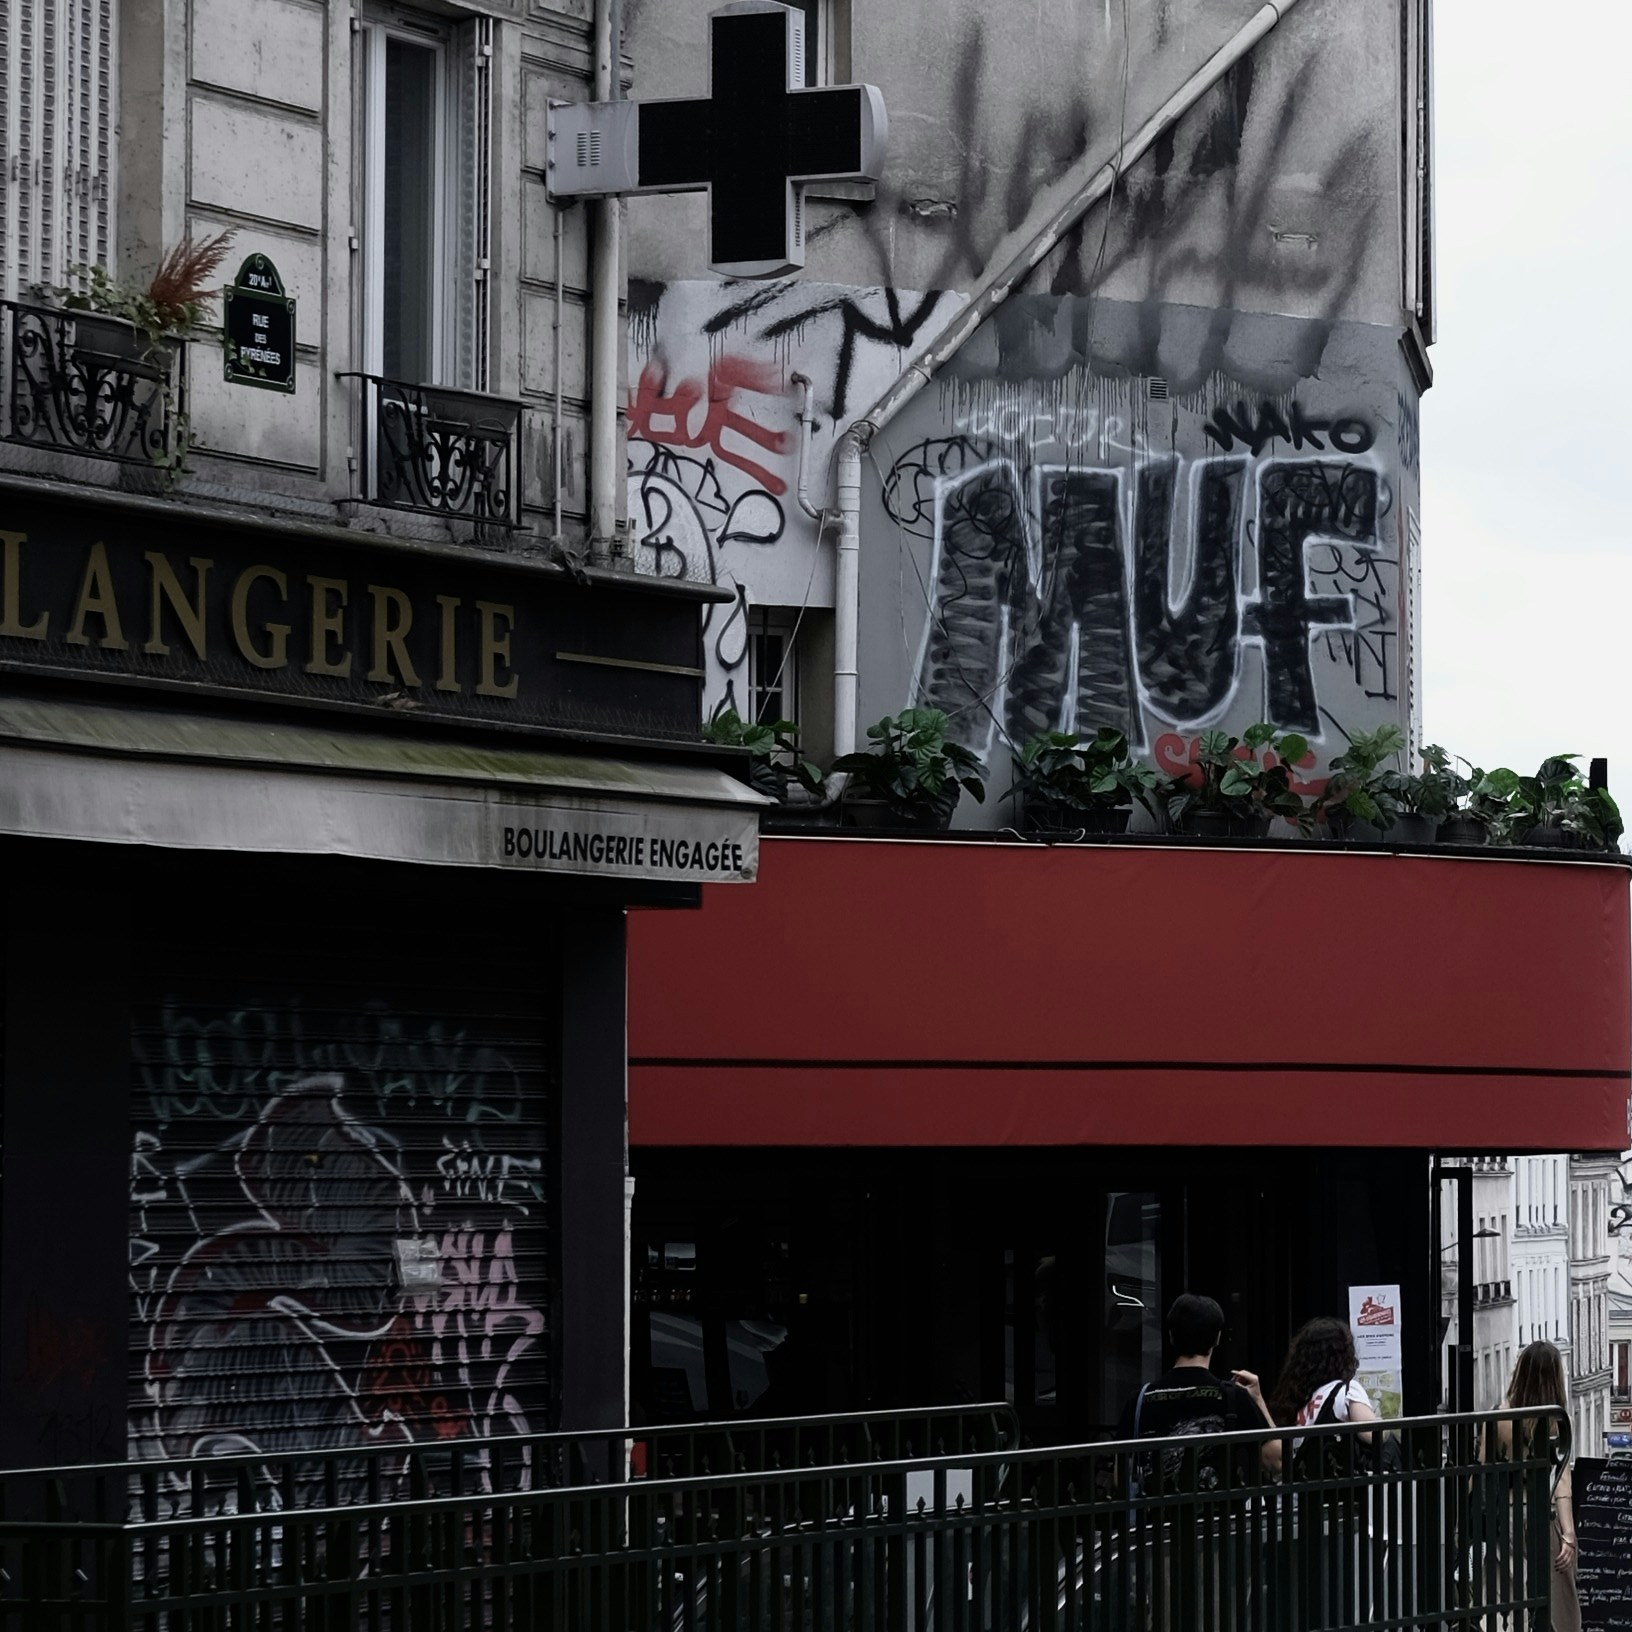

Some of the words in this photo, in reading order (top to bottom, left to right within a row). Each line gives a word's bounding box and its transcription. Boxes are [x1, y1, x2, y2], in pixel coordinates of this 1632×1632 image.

[252, 313, 270, 328] RUE
[254, 333, 267, 344] DES
[240, 346, 281, 365] PYRÉNÉES
[503, 826, 644, 867] BOULANGERIE
[651, 837, 743, 872] ENGAGÉE
